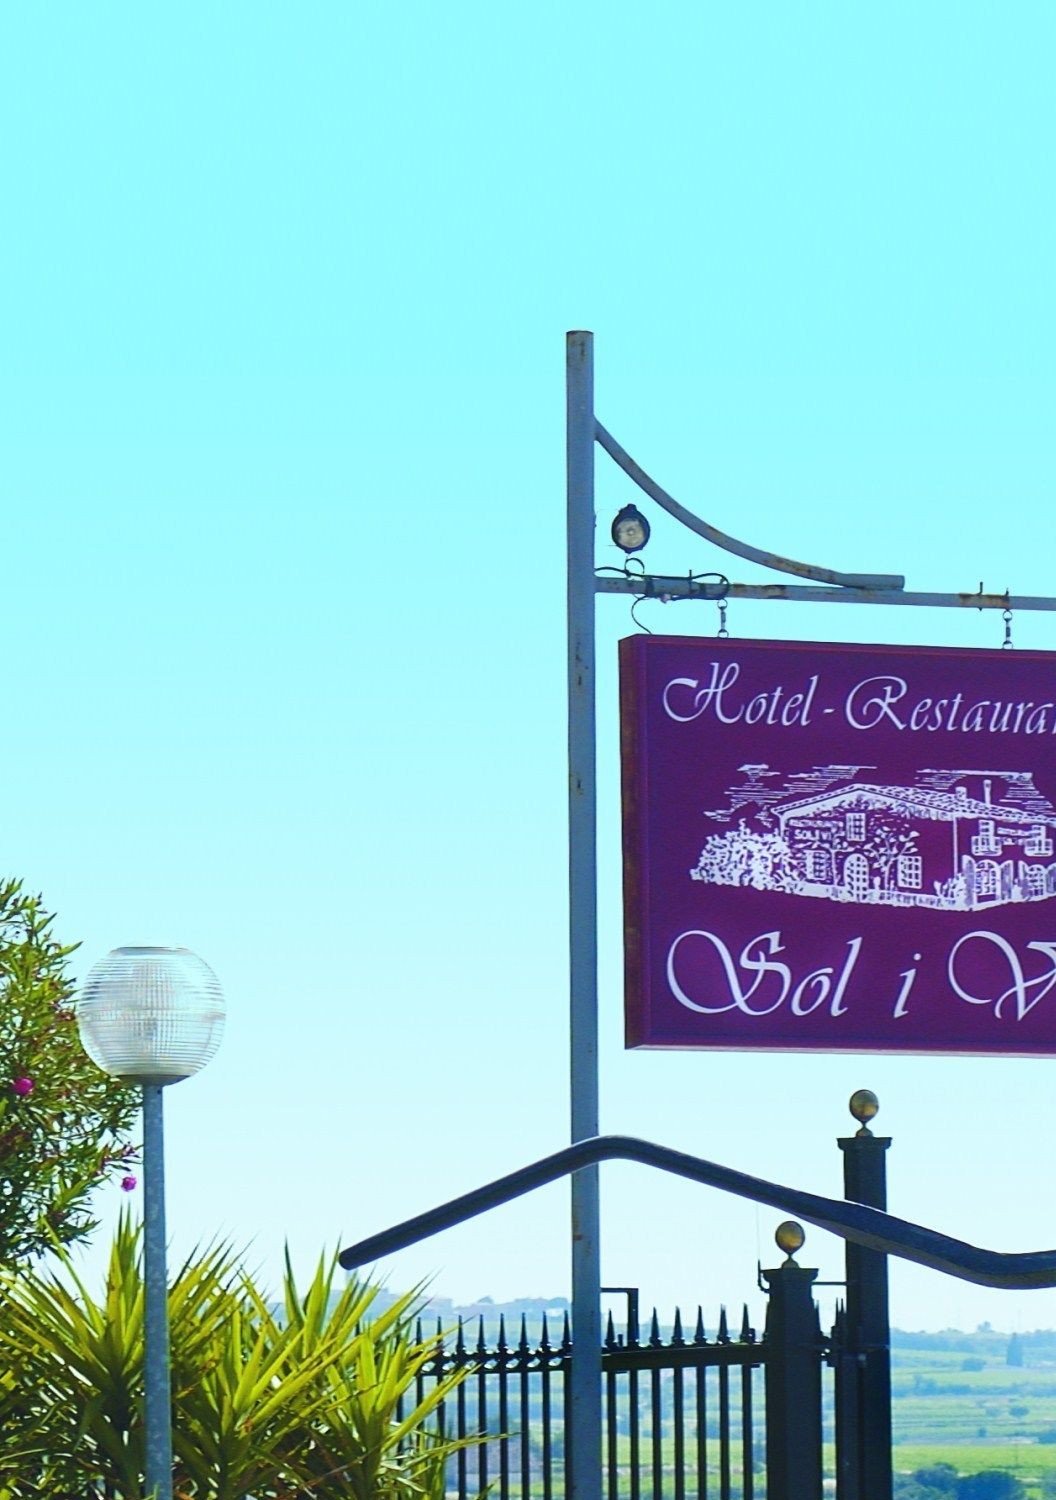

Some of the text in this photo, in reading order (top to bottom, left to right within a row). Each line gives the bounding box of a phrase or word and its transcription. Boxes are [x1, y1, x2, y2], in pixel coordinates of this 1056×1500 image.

[662, 661, 819, 727] Hotel
[666, 929, 862, 1017] Sol
[893, 953, 922, 1019] i
